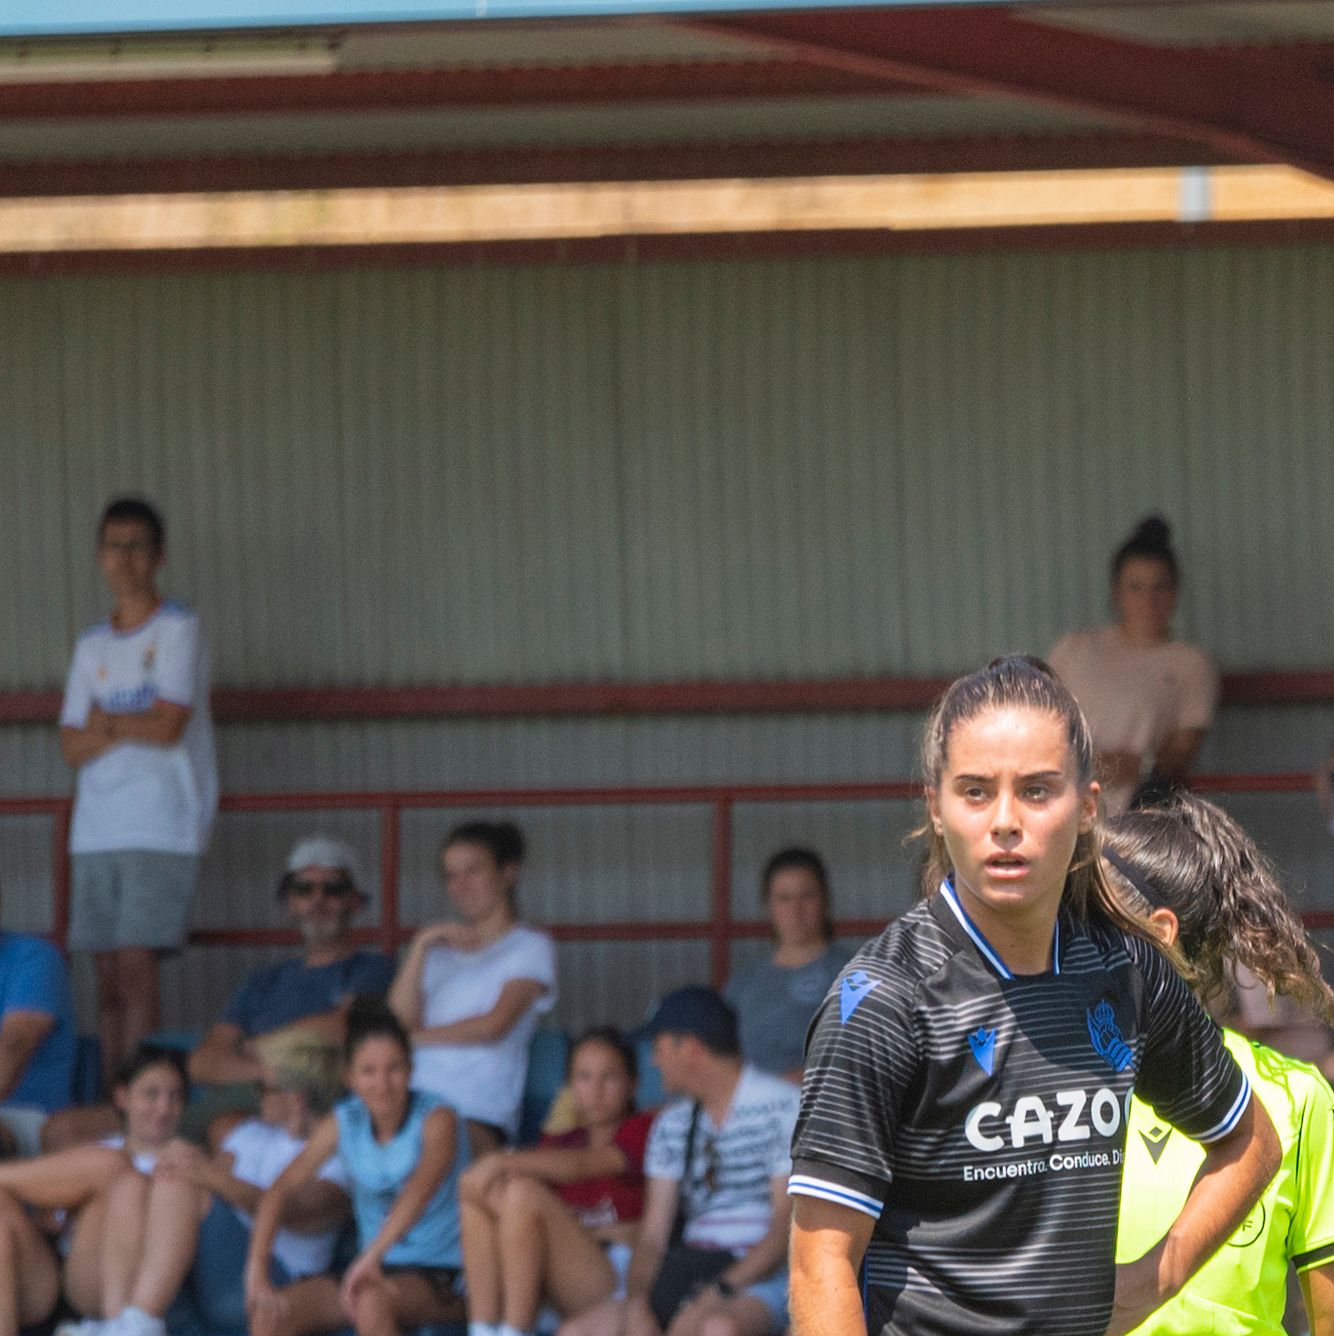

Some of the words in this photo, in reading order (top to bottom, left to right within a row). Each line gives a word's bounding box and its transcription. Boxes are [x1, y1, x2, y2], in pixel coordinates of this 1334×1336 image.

[964, 1086, 1134, 1152] CAZO
[963, 1158, 1048, 1182] Encuentra.
[1049, 1150, 1111, 1171] Conduce.
